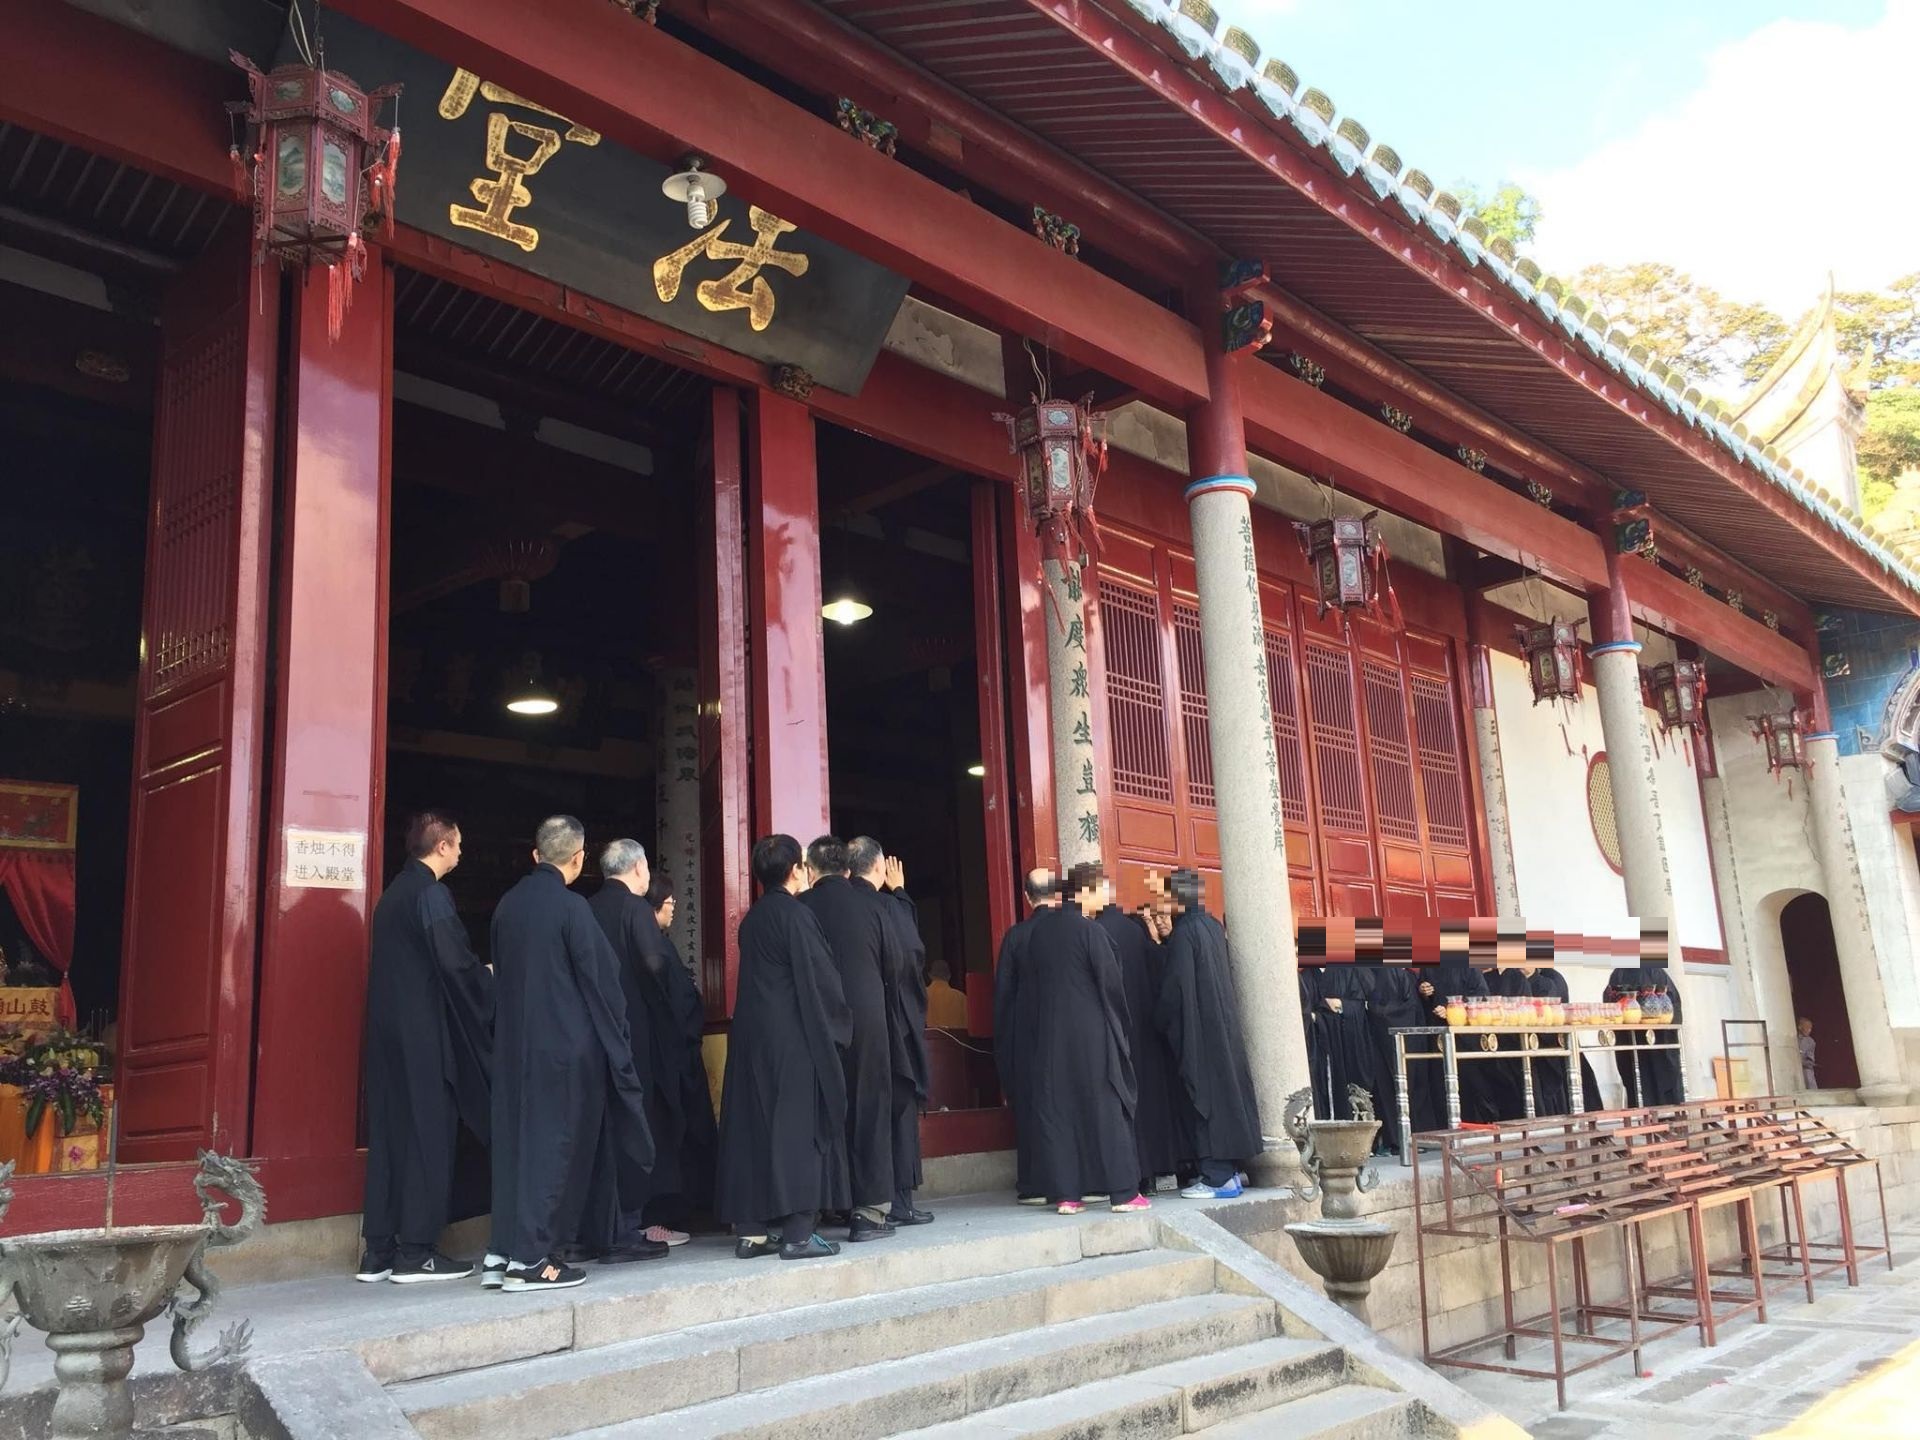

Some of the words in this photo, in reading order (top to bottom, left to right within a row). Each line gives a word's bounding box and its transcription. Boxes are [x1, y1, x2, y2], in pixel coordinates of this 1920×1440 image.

[295, 839, 355, 857] 香烛不得
[294, 864, 355, 882] 进入殿堂
